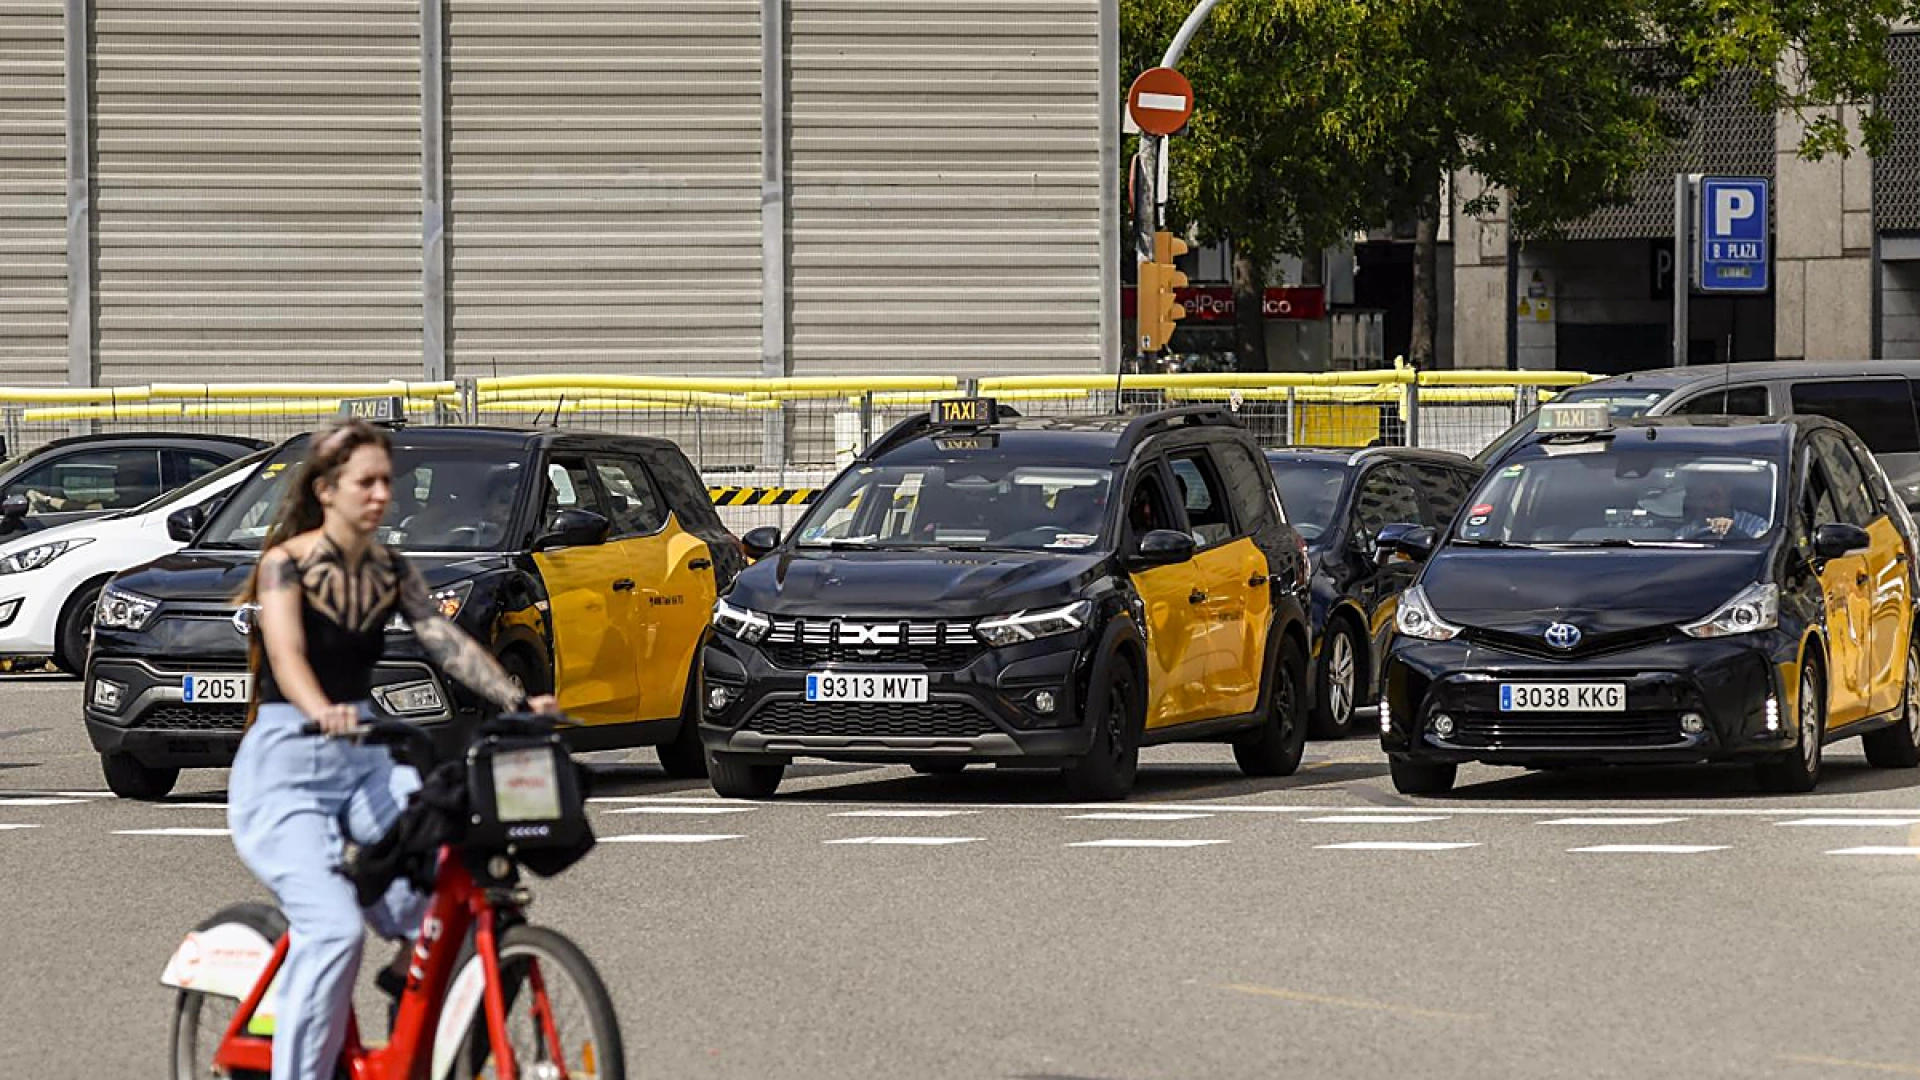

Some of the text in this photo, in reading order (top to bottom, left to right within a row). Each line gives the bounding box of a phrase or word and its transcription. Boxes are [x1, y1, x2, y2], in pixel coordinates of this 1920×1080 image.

[1716, 188, 1755, 236] P
[1728, 243, 1758, 259] PLAZA
[351, 401, 377, 418] TAXI
[942, 401, 976, 420] TAXI
[1554, 409, 1585, 427] TAXI
[197, 679, 247, 700] 2051
[823, 677, 922, 699] 9313 MVT
[1516, 687, 1619, 708] 3038 KKG
